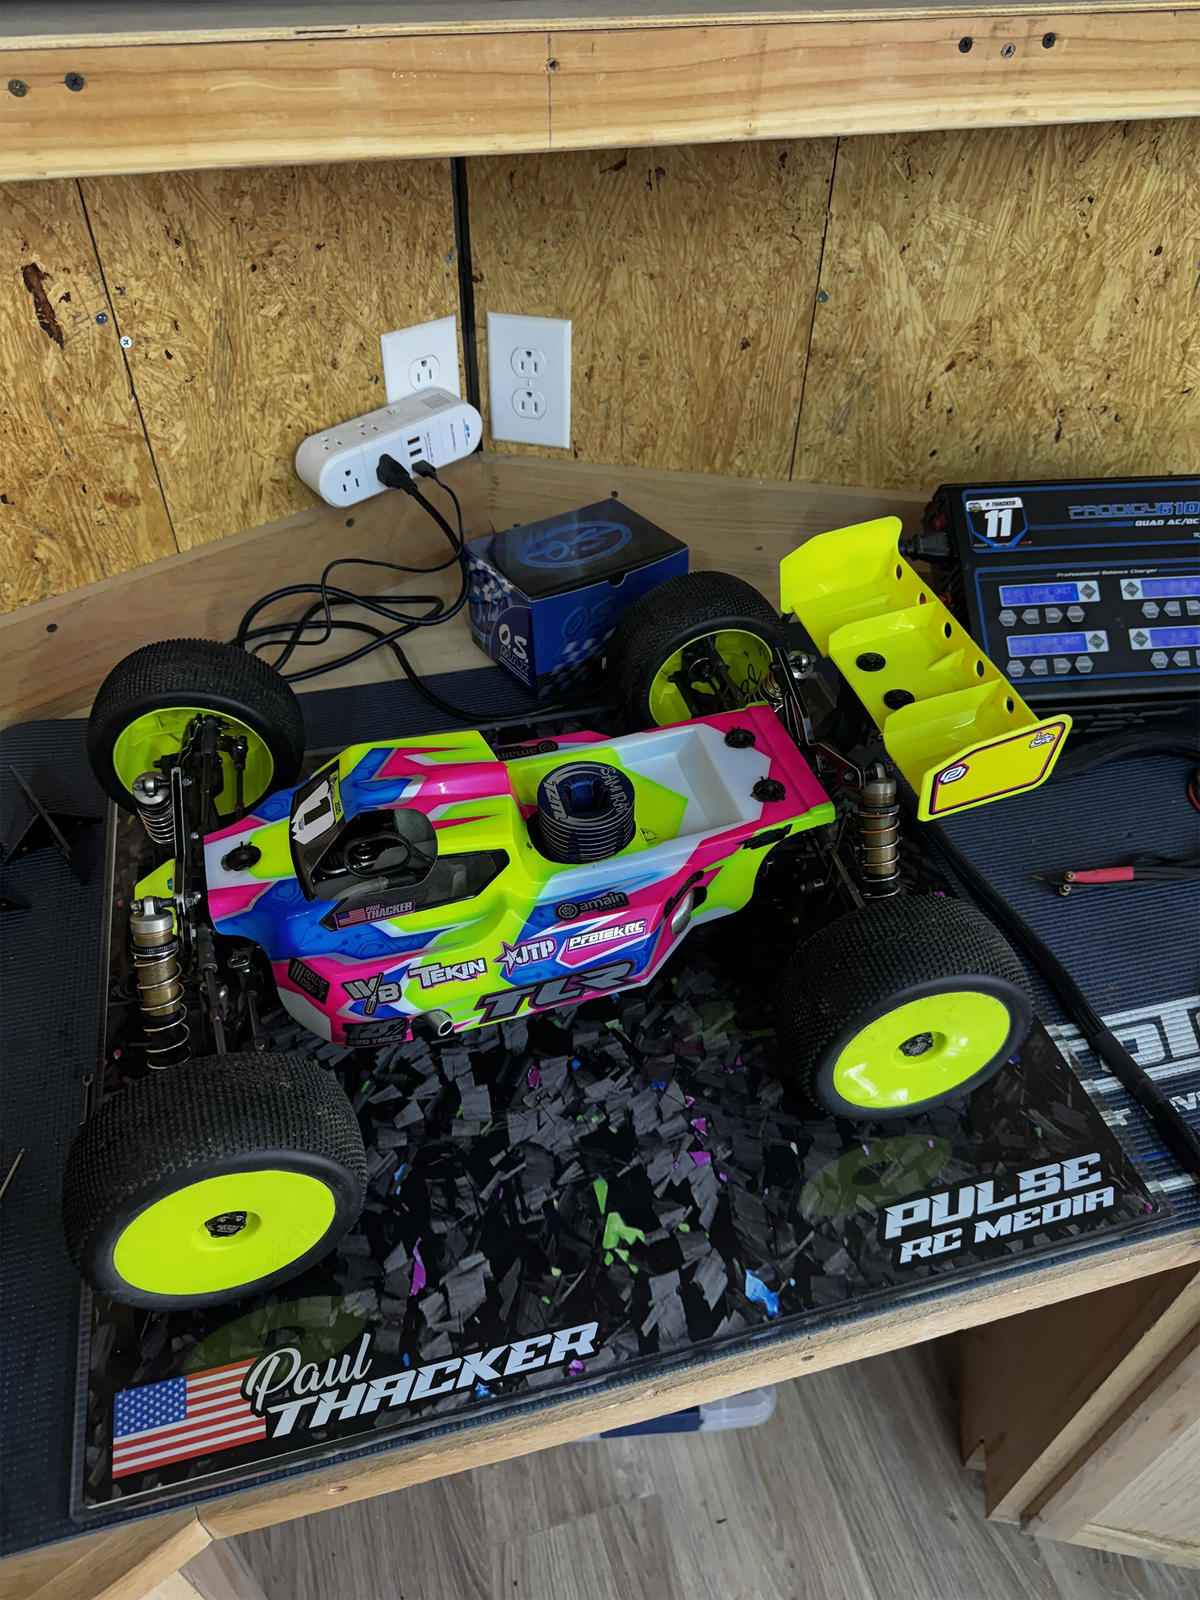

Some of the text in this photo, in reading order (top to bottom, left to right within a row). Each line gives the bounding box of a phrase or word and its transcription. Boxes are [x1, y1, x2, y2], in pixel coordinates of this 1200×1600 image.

[984, 509, 1013, 538] 11
[366, 901, 413, 920] THACKER
[580, 893, 626, 911] amain
[514, 940, 555, 965] JTP
[303, 969, 327, 991] RACE
[409, 959, 486, 988] TEKIN
[300, 978, 326, 999] CRAFT
[483, 962, 634, 1021] TLR
[884, 1152, 1102, 1240] PULSE
[900, 1186, 1115, 1264] RC MEDIA
[245, 1332, 375, 1411] Paul
[267, 1321, 599, 1439] THACKER
